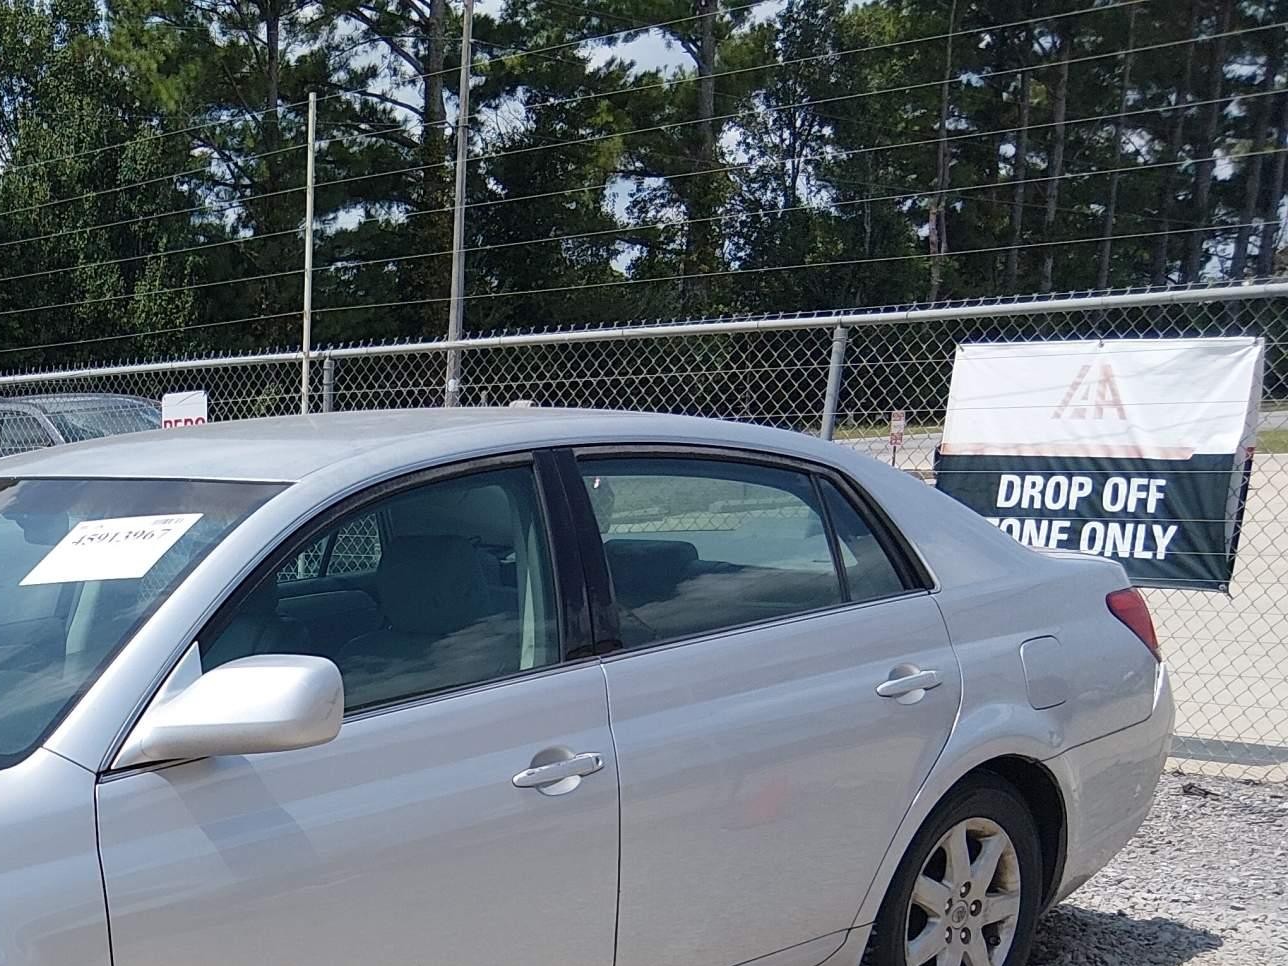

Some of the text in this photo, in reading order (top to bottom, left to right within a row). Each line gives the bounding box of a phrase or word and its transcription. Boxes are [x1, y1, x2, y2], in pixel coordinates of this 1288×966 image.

[996, 474, 1168, 513] DROP OFF
[986, 518, 1178, 560] ONE ONLY
